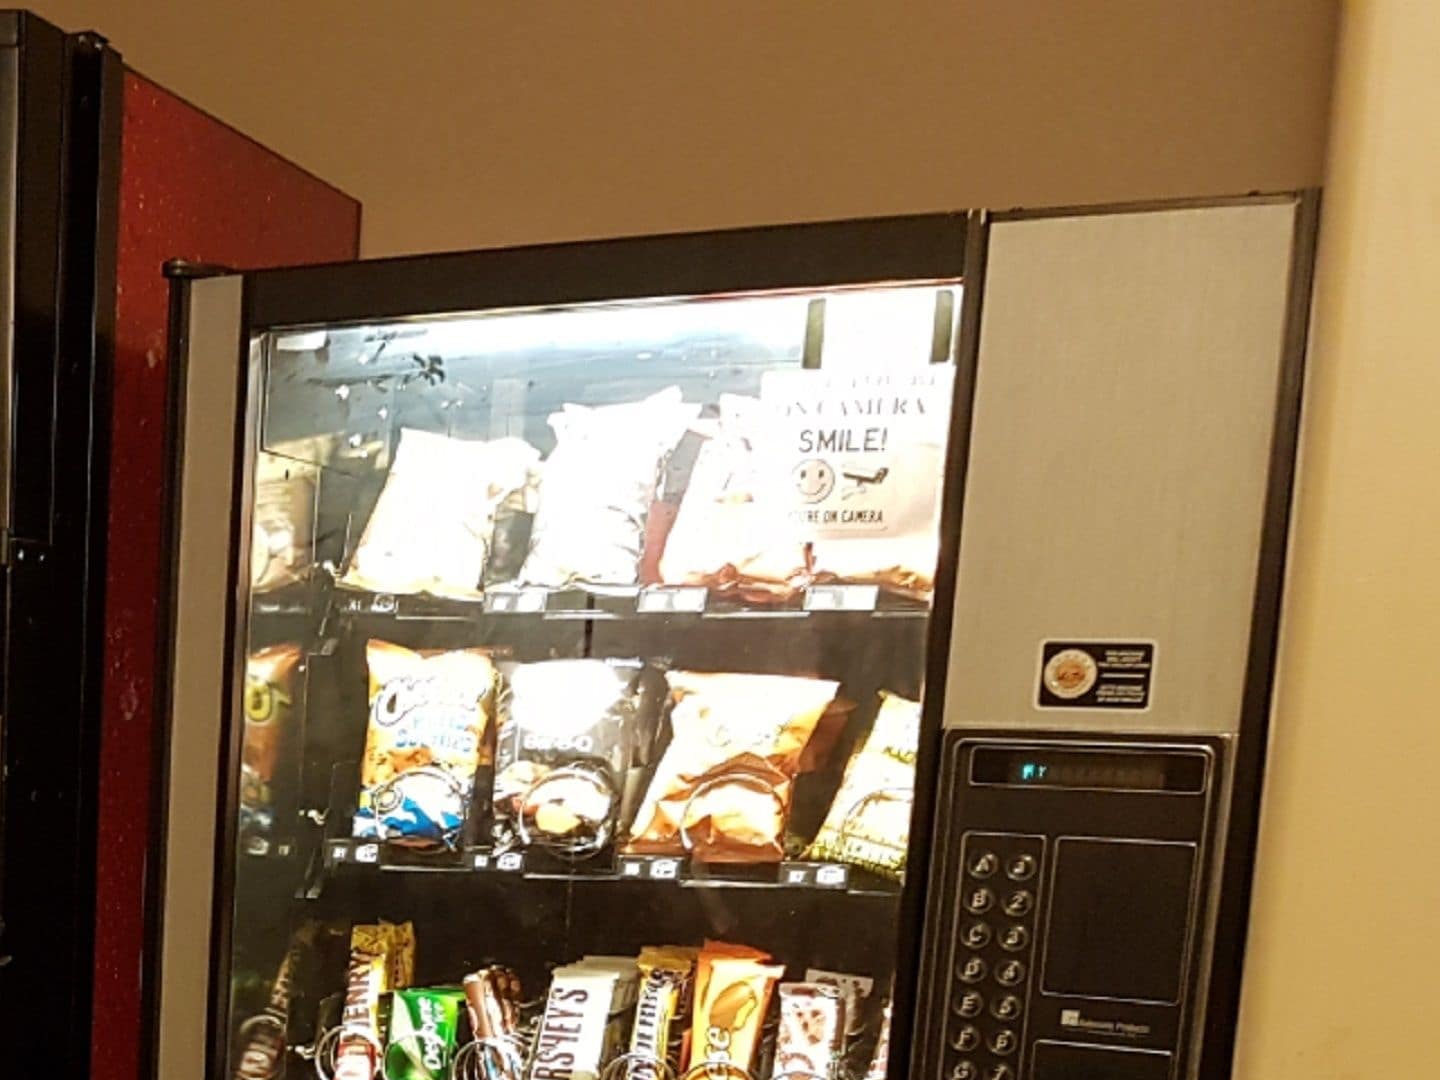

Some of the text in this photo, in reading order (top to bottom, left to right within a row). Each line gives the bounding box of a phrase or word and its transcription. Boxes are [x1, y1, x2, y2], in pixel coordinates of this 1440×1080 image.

[798, 427, 889, 454] SMILE!
[823, 511, 838, 523] ON
[841, 510, 884, 524] CAMERA
